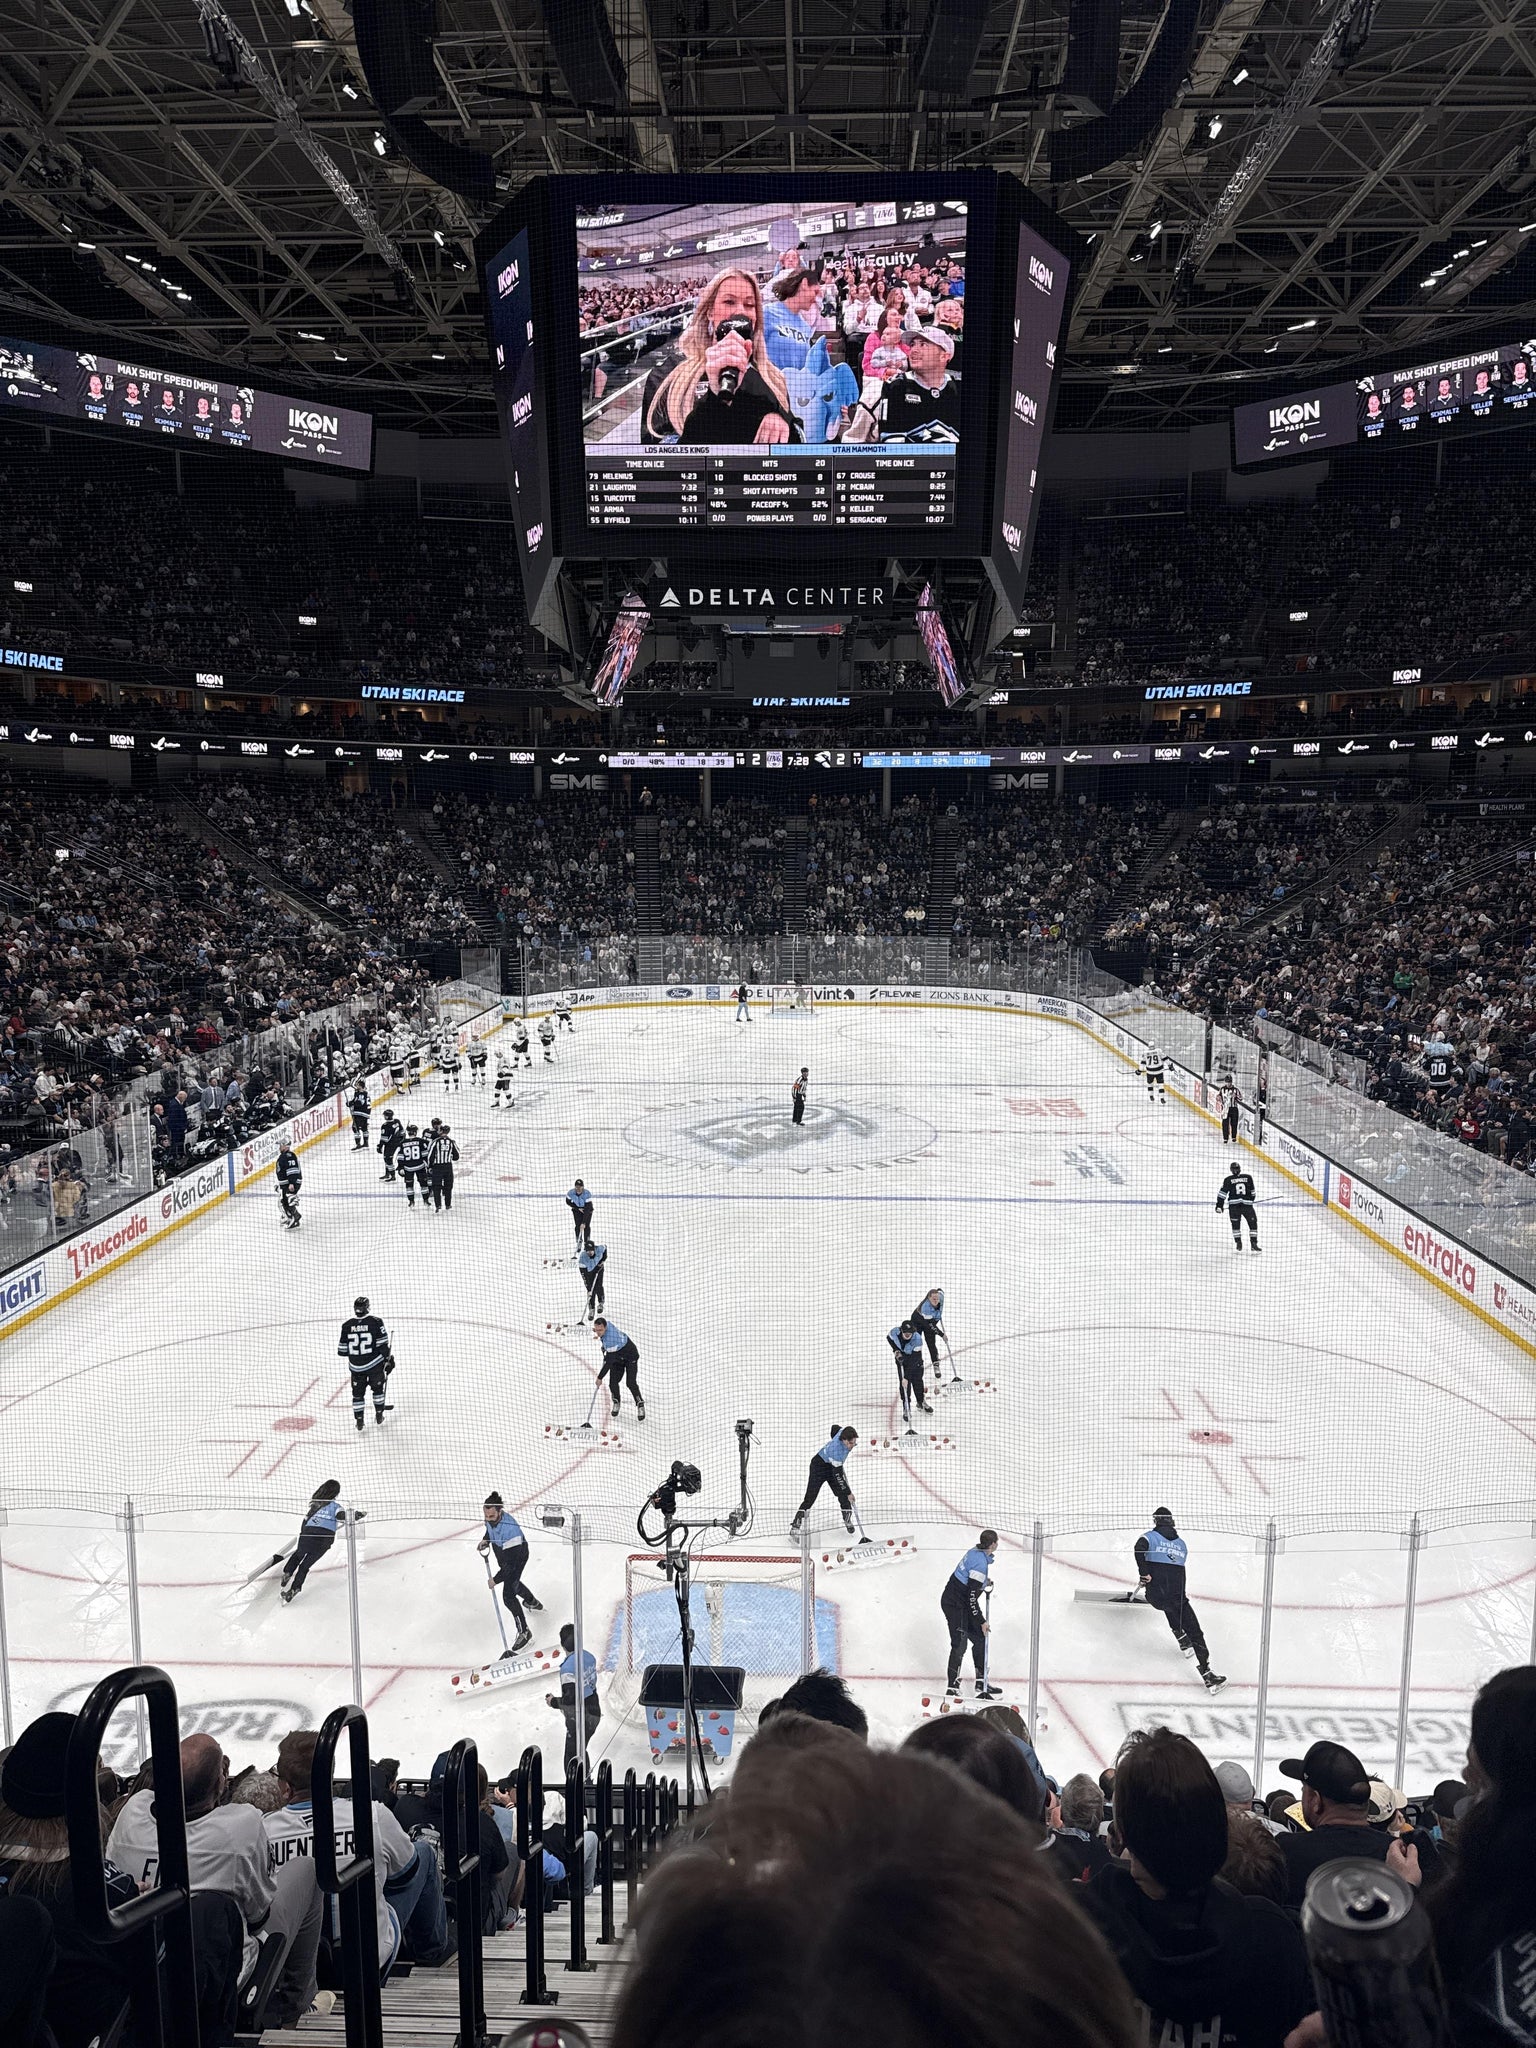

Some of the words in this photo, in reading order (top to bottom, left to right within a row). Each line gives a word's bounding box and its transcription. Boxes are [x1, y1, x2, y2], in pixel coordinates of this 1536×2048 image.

[903, 204, 935, 219] 7:28
[497, 259, 519, 293] IKON
[1029, 256, 1053, 289] IKON
[118, 364, 138, 376] MAX
[139, 369, 162, 382] SHOT
[164, 374, 192, 388] SPEED
[1394, 371, 1413, 383] MAX
[1415, 365, 1438, 378] SHOT
[1440, 358, 1469, 373] SPEED
[512, 392, 531, 422] IKON
[1015, 390, 1037, 420] IKON
[1270, 400, 1320, 428] IKON
[126, 419, 140, 427] 72.0
[289, 408, 338, 435] IKON
[1285, 423, 1304, 432] PASS
[1402, 423, 1416, 431] 72.0
[303, 430, 322, 439] PASS
[813, 514, 826, 522] 0/0
[527, 522, 543, 548] IKON
[689, 588, 776, 606] DELTA
[786, 587, 884, 606] CENTER
[5, 650, 27, 666] SKI
[29, 652, 64, 671] RACE
[196, 673, 223, 685] IKON
[1393, 668, 1421, 682] IKON
[361, 686, 400, 700] UTAH
[402, 688, 426, 700] SKI
[427, 689, 465, 703] RACE
[1145, 686, 1185, 700] UTAH
[1186, 684, 1212, 697] SKI
[1214, 681, 1252, 696] RACE
[110, 734, 135, 746] IKON
[1431, 736, 1458, 747] IKON
[241, 742, 267, 754] IKON
[376, 748, 402, 758] IKON
[1155, 748, 1181, 758] IKON
[1293, 743, 1320, 754] IKON
[510, 752, 534, 761] IKON
[752, 754, 761, 765] 2
[787, 756, 809, 766] 7:28
[836, 753, 845, 765] 2
[853, 757, 862, 765] 17
[1020, 752, 1046, 760] IKON
[550, 774, 609, 790] SME
[990, 773, 1049, 789] SME
[669, 988, 689, 998] Ford
[880, 990, 921, 998] FILEVINE
[930, 990, 960, 1000] ZIONS
[964, 992, 989, 1002] BANK
[1038, 997, 1067, 1008] AMERICAN
[1041, 1006, 1067, 1016] EXPRESS
[1147, 1055, 1159, 1065] 79
[1431, 1062, 1446, 1076] 00
[403, 1146, 420, 1160] 98
[172, 1183, 195, 1214] Ken
[197, 1165, 224, 1199] Garff
[1353, 1191, 1384, 1224] TOYOTA
[79, 1214, 148, 1268] Trucordia
[1404, 1224, 1476, 1294] entrata
[348, 1333, 372, 1355] 22
[490, 1658, 533, 1679] trüfrü
[267, 1831, 355, 1868] UENTER
